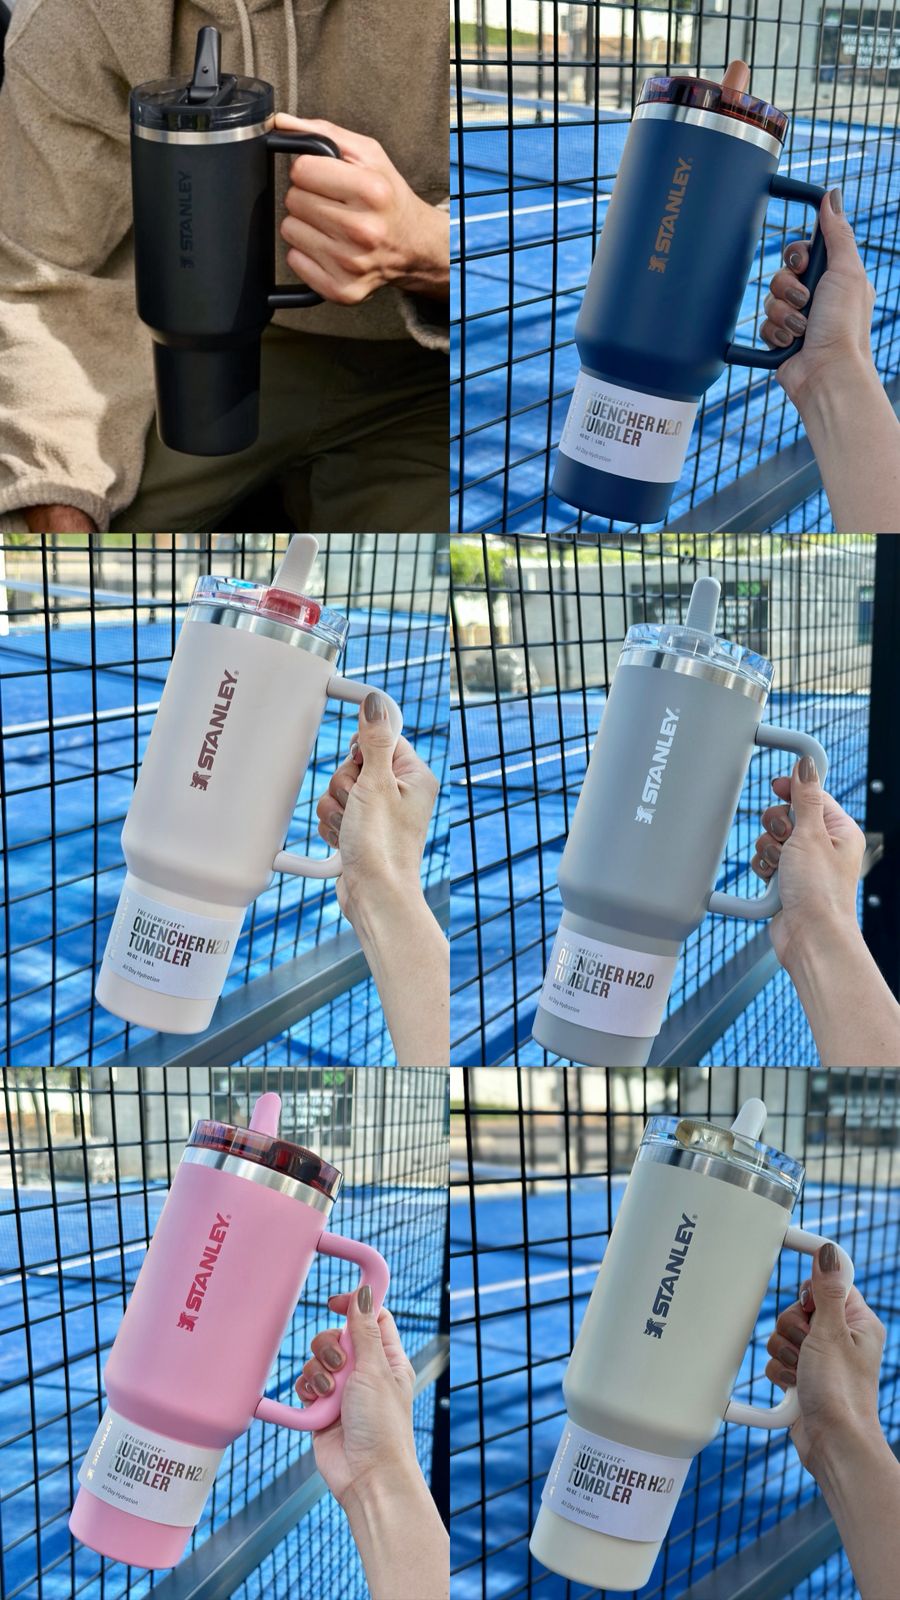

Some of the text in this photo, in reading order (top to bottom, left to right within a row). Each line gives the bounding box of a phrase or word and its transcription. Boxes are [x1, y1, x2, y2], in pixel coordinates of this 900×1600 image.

[178, 170, 193, 252] STANLEY
[129, 932, 193, 967] TUMBLER
[131, 916, 205, 952] QUENCHER
[205, 939, 230, 954] H2.0
[555, 965, 612, 998] TUMBLER
[558, 948, 654, 989] QUENCHER H2.0
[647, 1474, 674, 1494] H2.0
